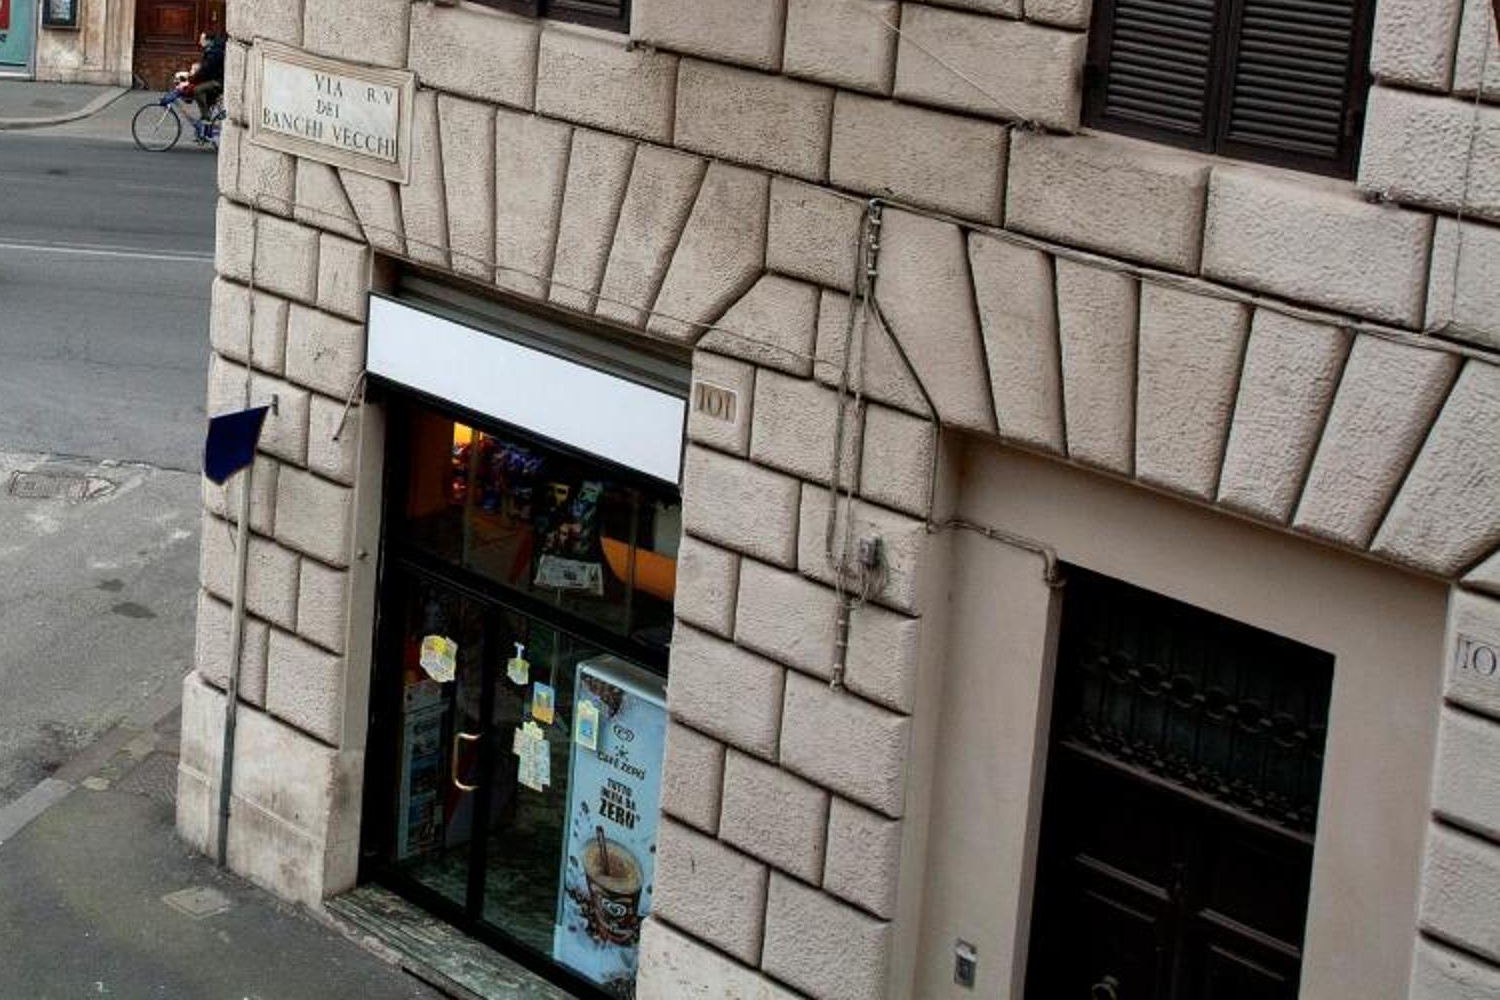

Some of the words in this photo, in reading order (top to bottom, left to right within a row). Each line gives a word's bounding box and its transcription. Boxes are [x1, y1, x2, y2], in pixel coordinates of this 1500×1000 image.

[314, 73, 344, 98] VIA
[315, 98, 340, 119] DEI
[262, 107, 324, 139] BANCHI
[332, 125, 396, 158] VECCHI
